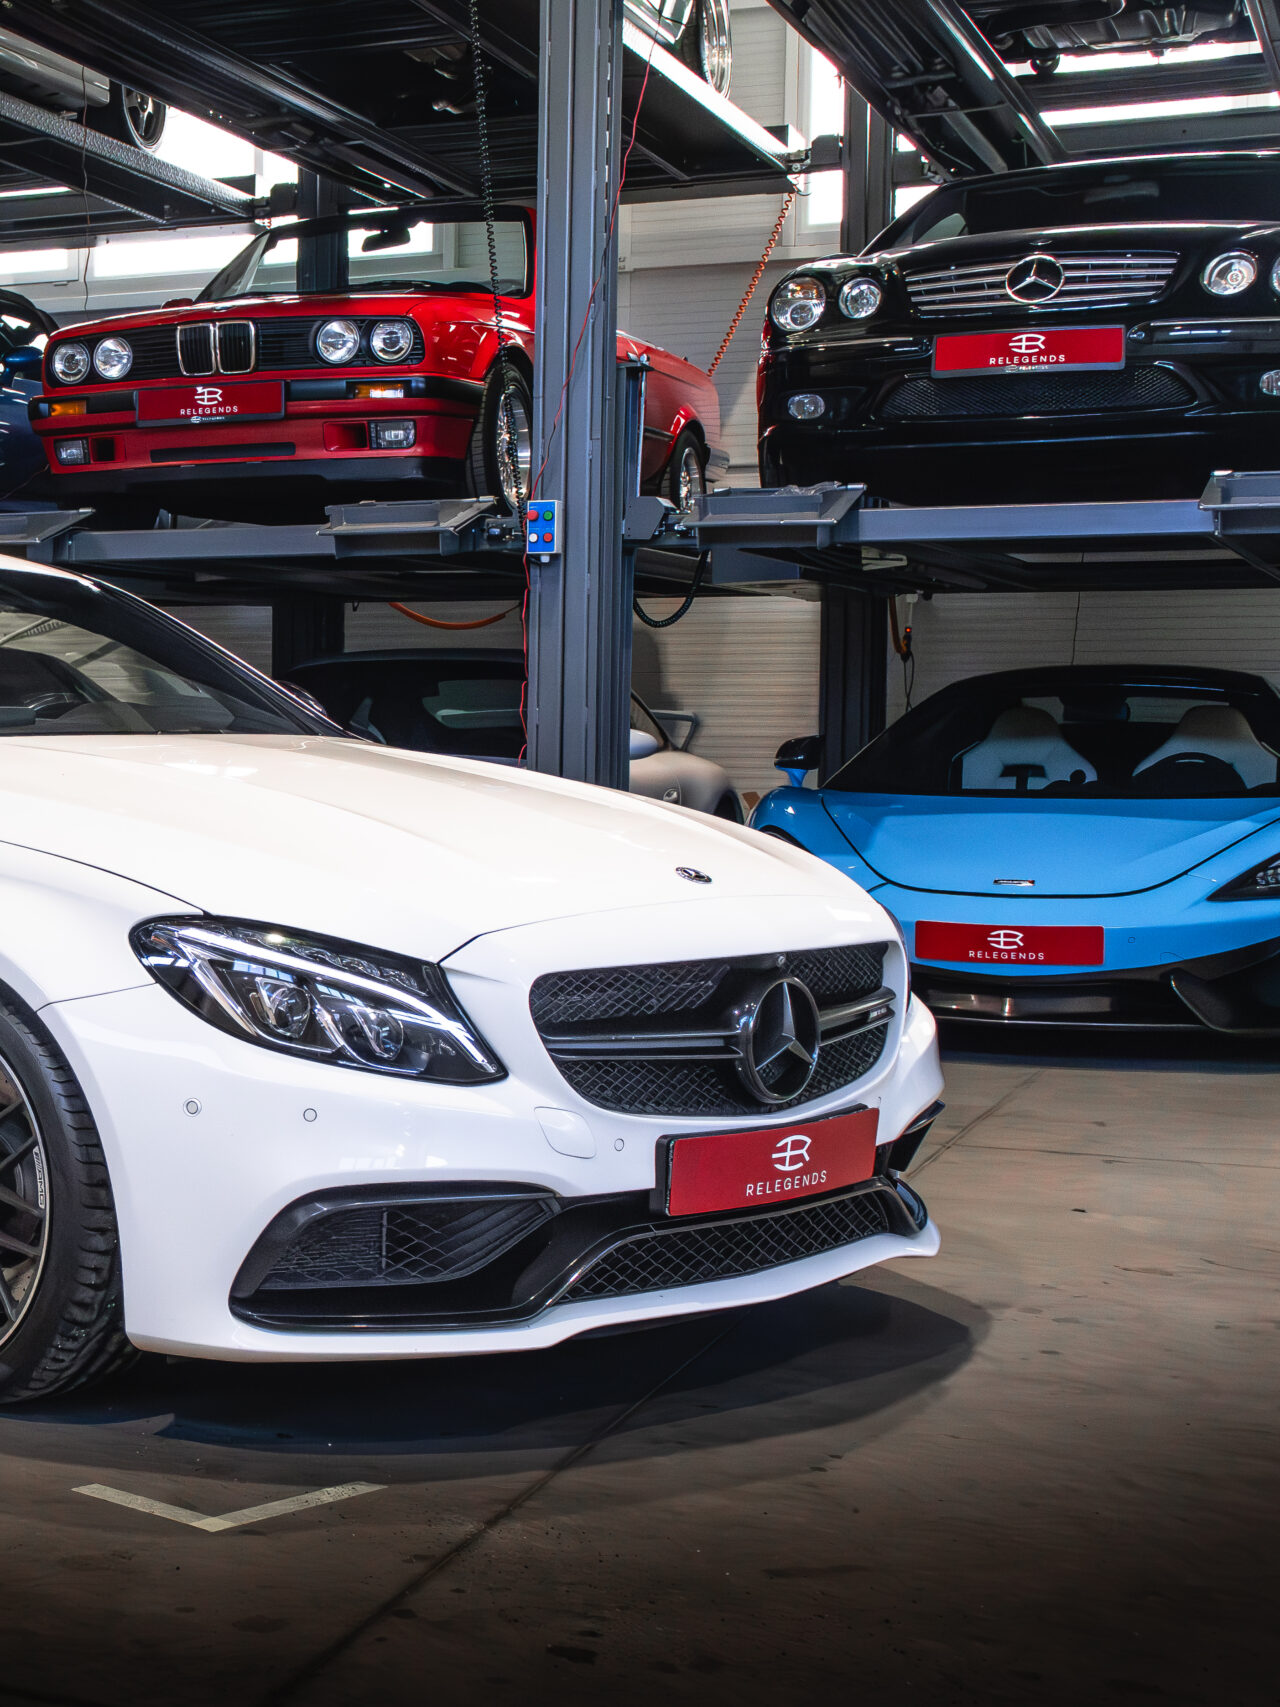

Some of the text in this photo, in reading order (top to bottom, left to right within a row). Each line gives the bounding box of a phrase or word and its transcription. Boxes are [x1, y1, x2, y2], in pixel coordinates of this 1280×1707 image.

[989, 354, 1066, 365] RELEGENDS
[180, 405, 238, 416] RELEGENDS
[968, 950, 1045, 960] RELEGENDS
[745, 1170, 827, 1197] RELEGENDS
